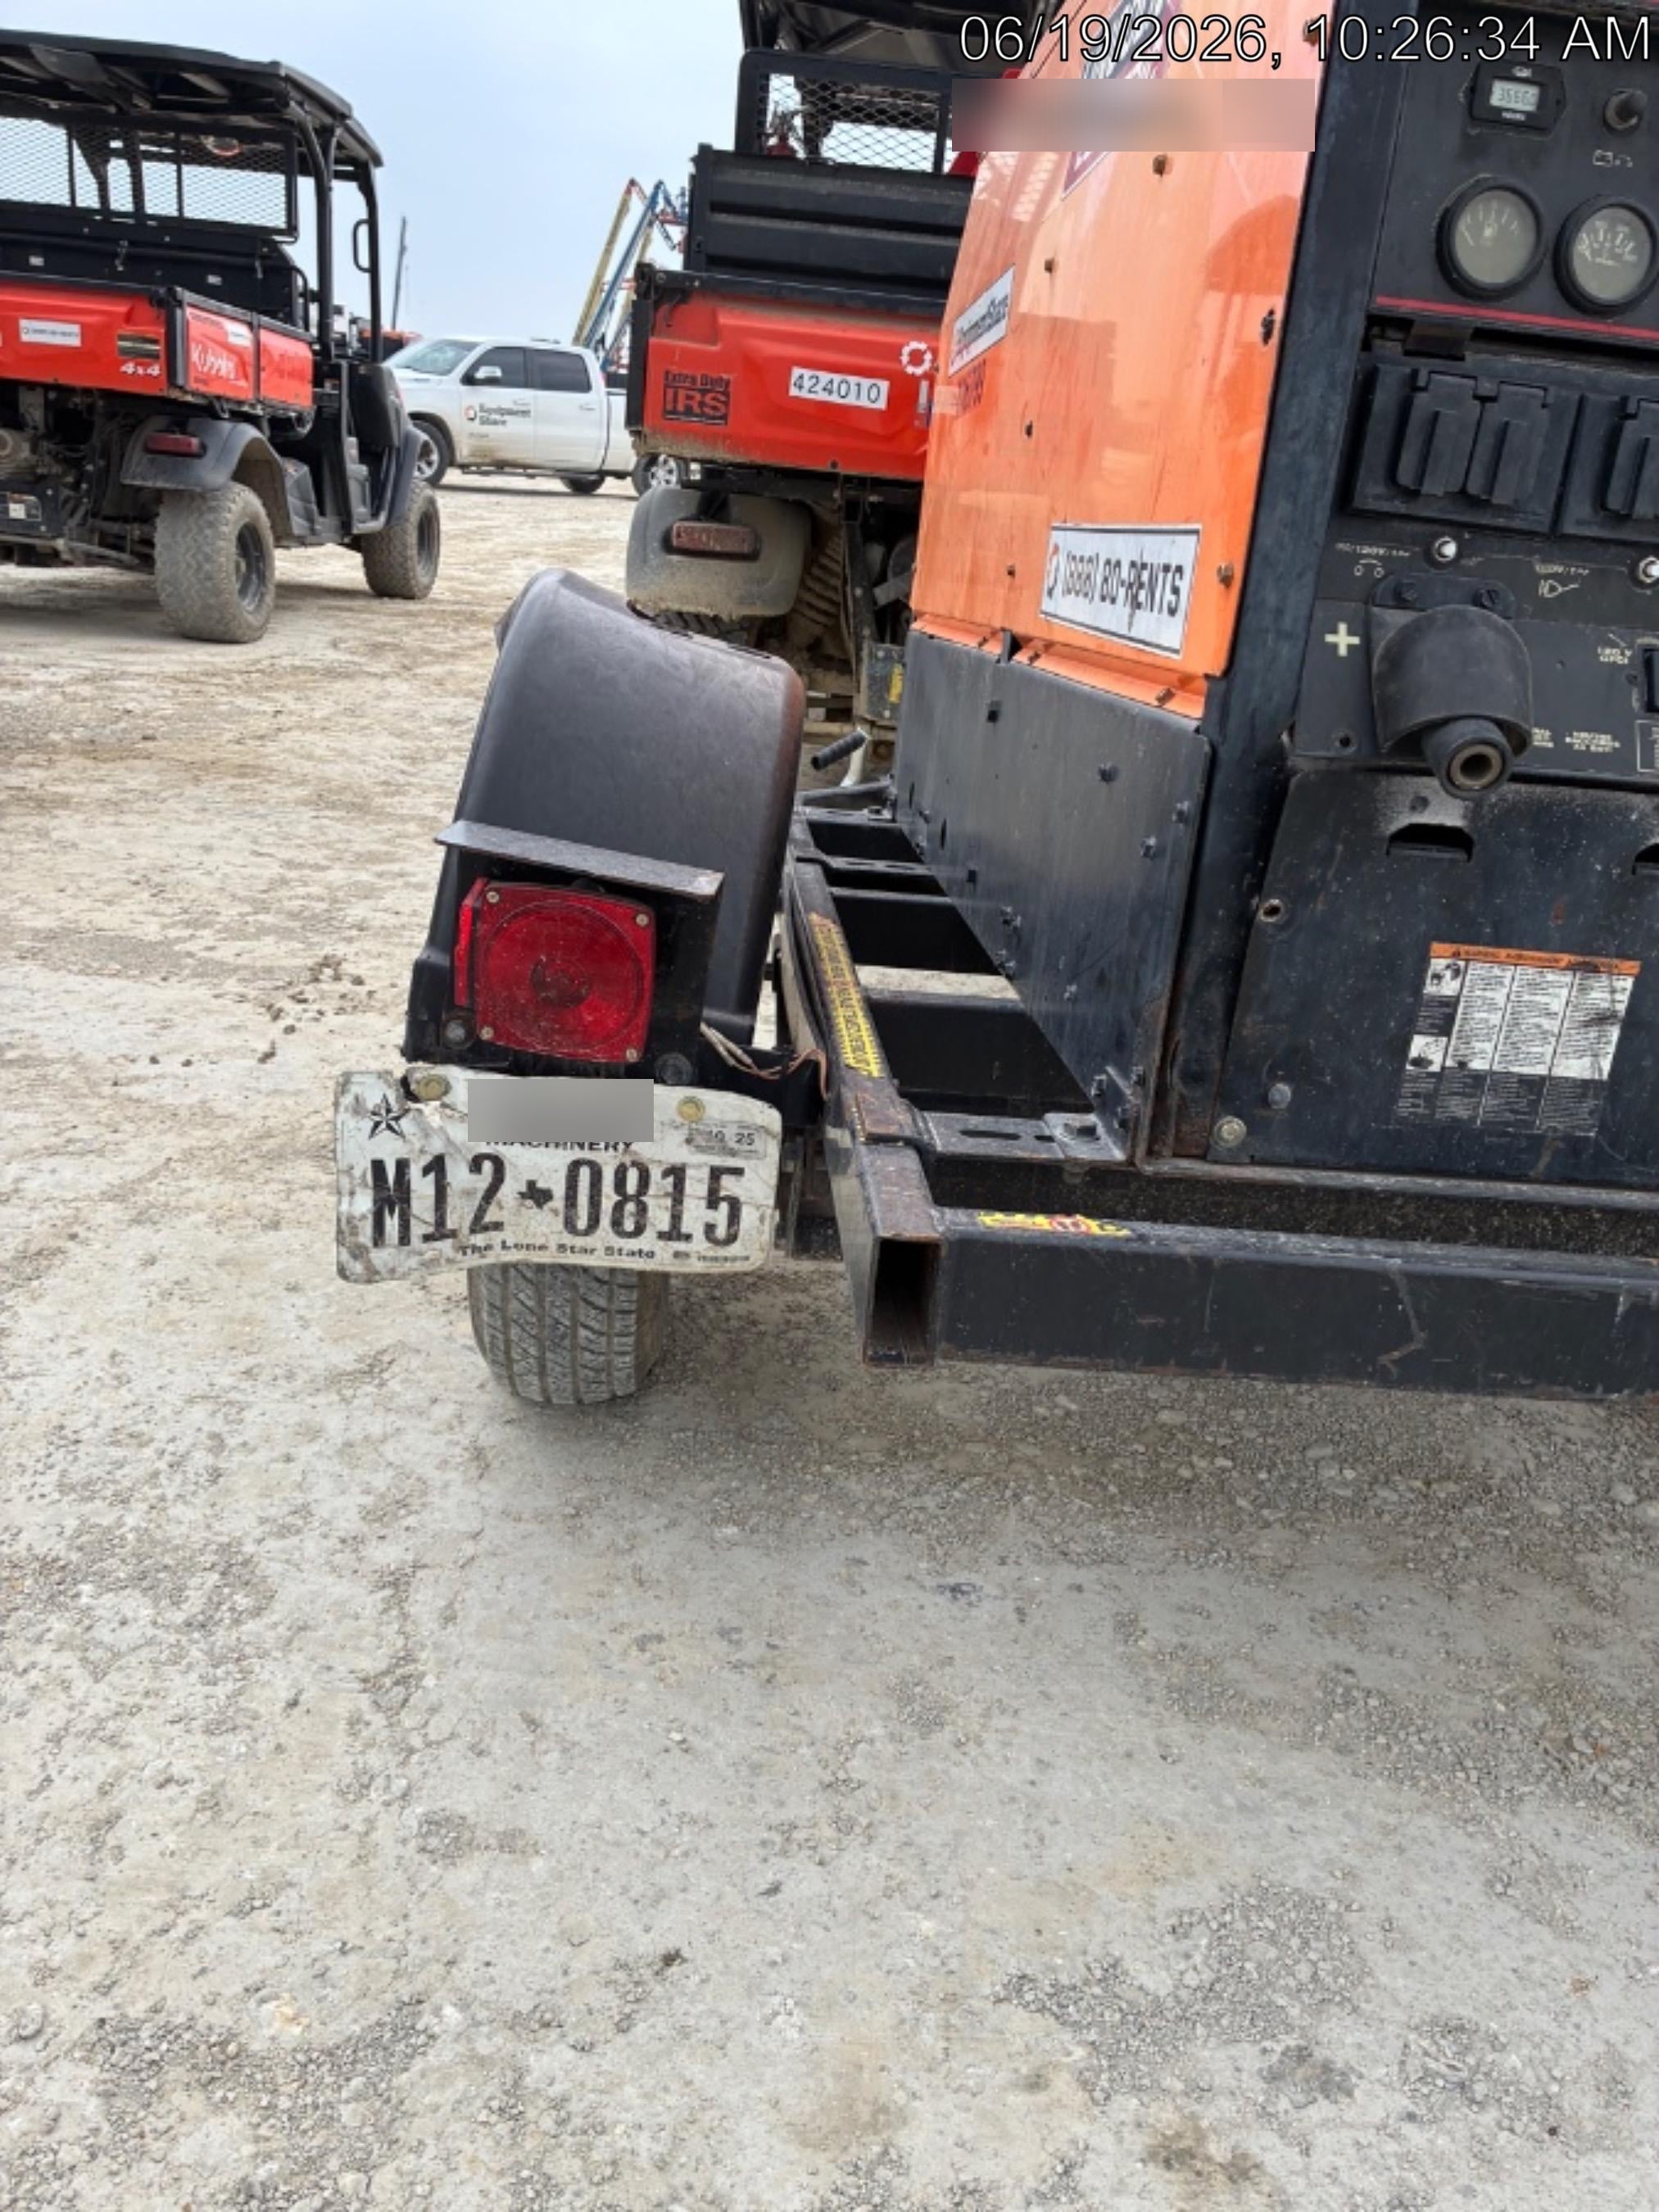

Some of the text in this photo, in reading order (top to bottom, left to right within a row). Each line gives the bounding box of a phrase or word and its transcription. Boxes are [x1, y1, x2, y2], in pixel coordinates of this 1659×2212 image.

[665, 388, 728, 416] IRS
[792, 372, 882, 404] 424010
[734, 1131, 755, 1146] 25
[369, 1150, 746, 1248] M12 0815
[457, 1241, 492, 1257] The
[499, 1240, 549, 1253] Lone
[555, 1243, 597, 1256] Star
[603, 1244, 656, 1260] State
